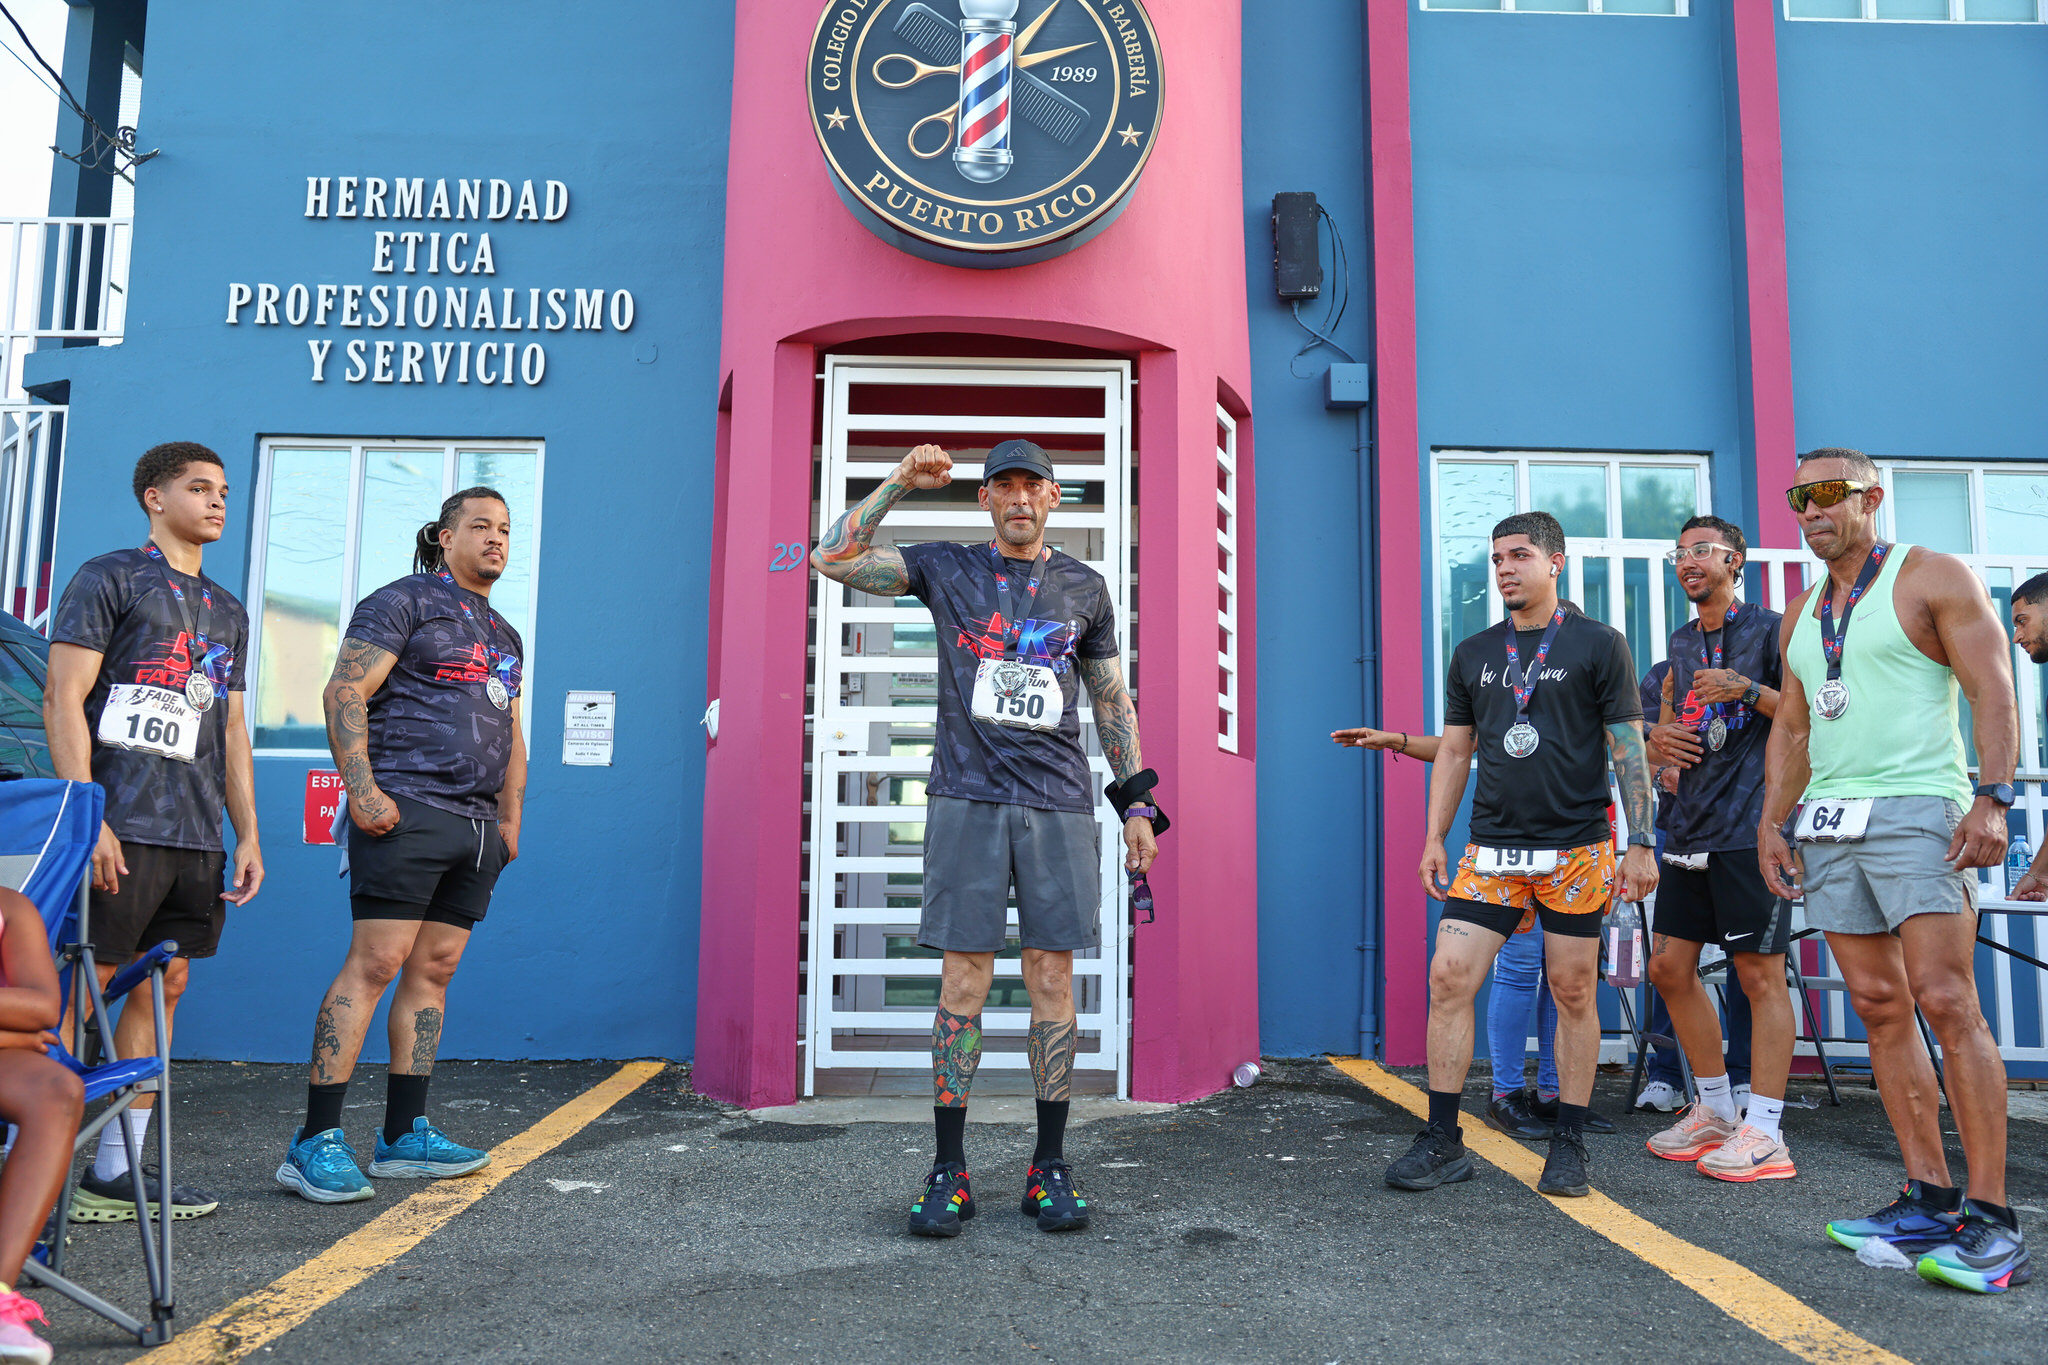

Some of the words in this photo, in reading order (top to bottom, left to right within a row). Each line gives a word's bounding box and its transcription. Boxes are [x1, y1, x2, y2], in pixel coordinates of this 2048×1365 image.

[823, 7, 859, 92] COLEGIO
[1049, 65, 1098, 84] 1989
[304, 176, 569, 221] HERMANDAD
[864, 170, 1003, 235] PUERTO
[1013, 183, 1097, 232] RICO
[372, 231, 495, 274] ETICA
[225, 282, 634, 331] PROFESIONALISMO
[308, 339, 332, 382] Y
[345, 339, 545, 386] SERVICIO
[769, 543, 805, 572] 29
[135, 668, 189, 688] FADE
[146, 689, 179, 705] FADE
[160, 704, 186, 717] RUN
[569, 694, 612, 702] WARNING
[994, 693, 1045, 719] 150
[126, 713, 180, 748] 160
[571, 730, 606, 739] AVISO
[1812, 806, 1845, 831] 64
